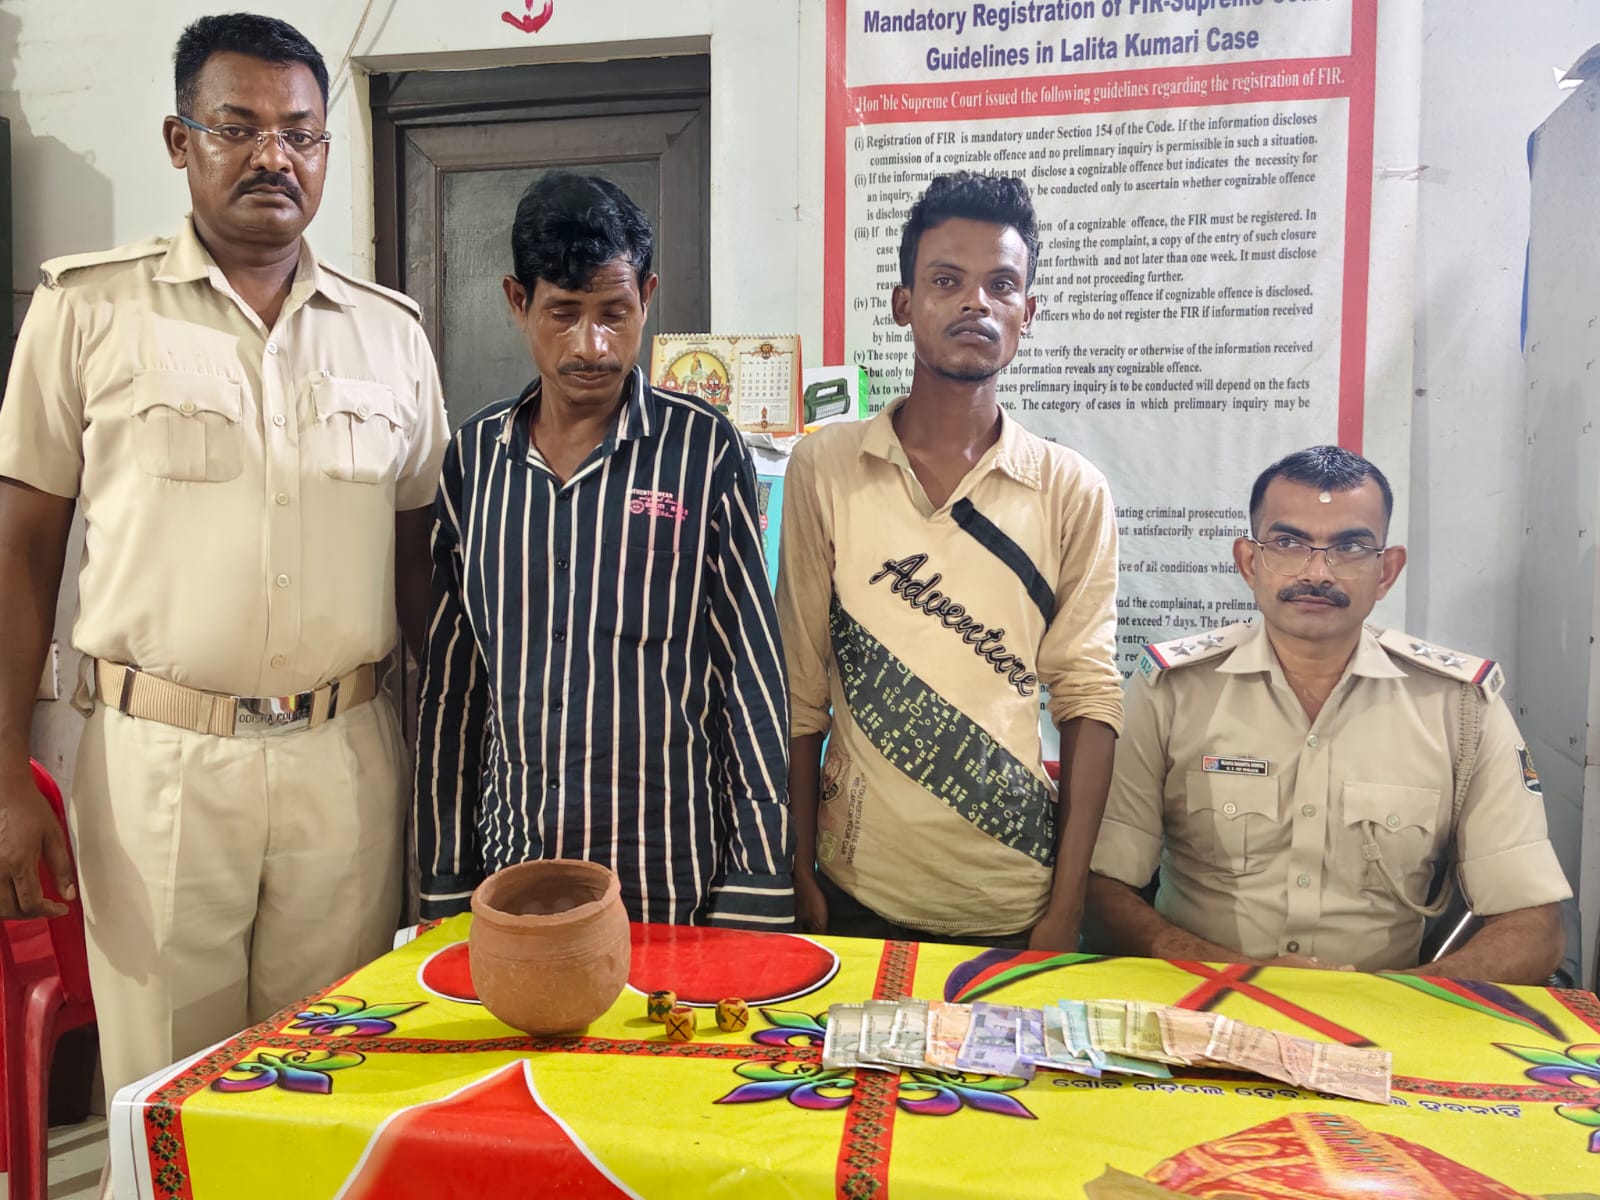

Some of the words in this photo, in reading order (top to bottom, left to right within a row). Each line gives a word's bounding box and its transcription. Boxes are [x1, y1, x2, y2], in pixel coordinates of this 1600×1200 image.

[864, 8, 966, 34] Mandatory
[972, 0, 1094, 31] Registration
[1101, 0, 1121, 17] of
[926, 44, 1029, 70] Guidelines
[1036, 40, 1053, 64] in
[1060, 36, 1117, 62] Lalita
[1125, 29, 1198, 57] Kumari
[1206, 27, 1259, 51] Case
[901, 93, 948, 113] Supreme
[950, 91, 982, 108] Court
[985, 88, 1017, 105] issued
[1020, 87, 1037, 104] the
[1040, 84, 1090, 104] following
[1093, 80, 1149, 103] guidelines
[1152, 76, 1207, 98] regarding
[1211, 74, 1228, 91] the
[1232, 69, 1299, 93] registration
[1302, 67, 1316, 86] of
[1318, 66, 1344, 85] FIR.
[866, 133, 922, 149] Registration
[936, 131, 956, 144] FIR
[970, 129, 1023, 143] mandatory
[1025, 127, 1054, 140] under
[1056, 125, 1092, 139] Section
[1095, 123, 1112, 136] 154
[1127, 121, 1144, 134] the
[1145, 119, 1175, 133] Code.
[1188, 117, 1206, 131] the
[1207, 114, 1269, 129] information
[1271, 112, 1318, 126] discloses
[869, 152, 921, 166] commission
[943, 149, 991, 165] cognizable
[993, 148, 1026, 161] offence
[1028, 146, 1046, 159] and
[1117, 141, 1153, 157] inquiry
[1165, 137, 1222, 155] permissible
[1236, 134, 1259, 148] such
[1270, 133, 1317, 146] situation.
[1011, 168, 1026, 178] not
[1031, 164, 1067, 177] disclose
[1077, 161, 1127, 177] cognizable
[1129, 159, 1163, 172] offence
[1166, 157, 1182, 170] but
[1185, 156, 1228, 169] indicates
[1234, 154, 1250, 167] the
[1255, 152, 1299, 167] necessity
[1302, 151, 1318, 164] for
[877, 171, 891, 184] the
[1050, 181, 1098, 194] conducted
[1100, 180, 1121, 195] only
[1135, 177, 1179, 191] ascertain
[1182, 175, 1222, 188] whether
[1224, 172, 1276, 189] cognizable
[1278, 171, 1315, 184] offence
[879, 188, 913, 203] inquiry,
[1076, 217, 1126, 233] cognizable
[1130, 215, 1167, 228] offence,
[1170, 214, 1185, 226] the
[1188, 213, 1207, 226] FIR
[1210, 213, 1234, 224] must
[1250, 209, 1302, 226] registered.
[854, 226, 869, 241] (iii)
[885, 225, 899, 237] the
[1048, 236, 1080, 251] closing
[1082, 235, 1097, 248] the
[1099, 234, 1149, 249] complaint,
[1159, 235, 1182, 247] copy
[1196, 231, 1212, 244] the
[1214, 232, 1240, 245] entry
[1255, 228, 1278, 242] such
[1280, 228, 1316, 240] closure
[876, 246, 894, 255] case
[1055, 254, 1098, 267] forthwith
[1103, 253, 1121, 265] and
[1123, 254, 1139, 265] not
[1141, 252, 1164, 264] later
[1166, 251, 1188, 263] than
[1190, 253, 1207, 263] one
[1210, 249, 1237, 262] week.
[1251, 249, 1275, 260] must
[1278, 246, 1317, 259] disclose
[876, 262, 897, 273] must
[1056, 273, 1073, 285] and
[1076, 274, 1091, 284] not
[1093, 271, 1145, 286] proceeding
[1147, 270, 1183, 282] further.
[1067, 290, 1117, 305] registering
[1119, 289, 1153, 301] offence
[1165, 287, 1215, 303] cognizable
[1217, 286, 1253, 299] offence
[1265, 283, 1313, 297] disclosed.
[853, 296, 868, 311] (iv)
[870, 296, 887, 308] The
[1036, 310, 1069, 321] officers
[1071, 308, 1090, 320] who
[1107, 309, 1122, 320] not
[1124, 307, 1160, 322] register
[1162, 306, 1177, 319] the
[1180, 305, 1199, 318] FIR
[1211, 304, 1269, 317] information
[1272, 302, 1313, 316] received
[886, 331, 902, 342] him
[867, 349, 883, 360] The
[885, 352, 908, 363] scope
[1018, 346, 1032, 357] not
[1044, 345, 1071, 360] verify
[1089, 344, 1125, 359] veracity
[1140, 343, 1184, 356] otherwise
[1214, 342, 1271, 354] information
[1273, 340, 1313, 353] received
[870, 367, 883, 377] but
[885, 366, 903, 380] only
[1010, 361, 1062, 374] information
[1064, 362, 1096, 374] reveals
[1116, 361, 1164, 376] cognizable
[1166, 361, 1202, 373] offence.
[1073, 379, 1108, 395] inquiry
[1144, 378, 1193, 391] conducted
[1195, 378, 1213, 391] will
[1215, 377, 1251, 393] depend
[1286, 377, 1310, 389] facts
[1041, 399, 1080, 413] category
[1097, 400, 1121, 410] cases
[1140, 397, 1168, 409] which
[1232, 396, 1268, 412] inquiry
[1146, 506, 1185, 518] criminal
[1133, 524, 1193, 539] satisfactorily
[1159, 560, 1208, 573] conditions
[869, 553, 1037, 696] Adventure
[1132, 615, 1162, 627] exceed
